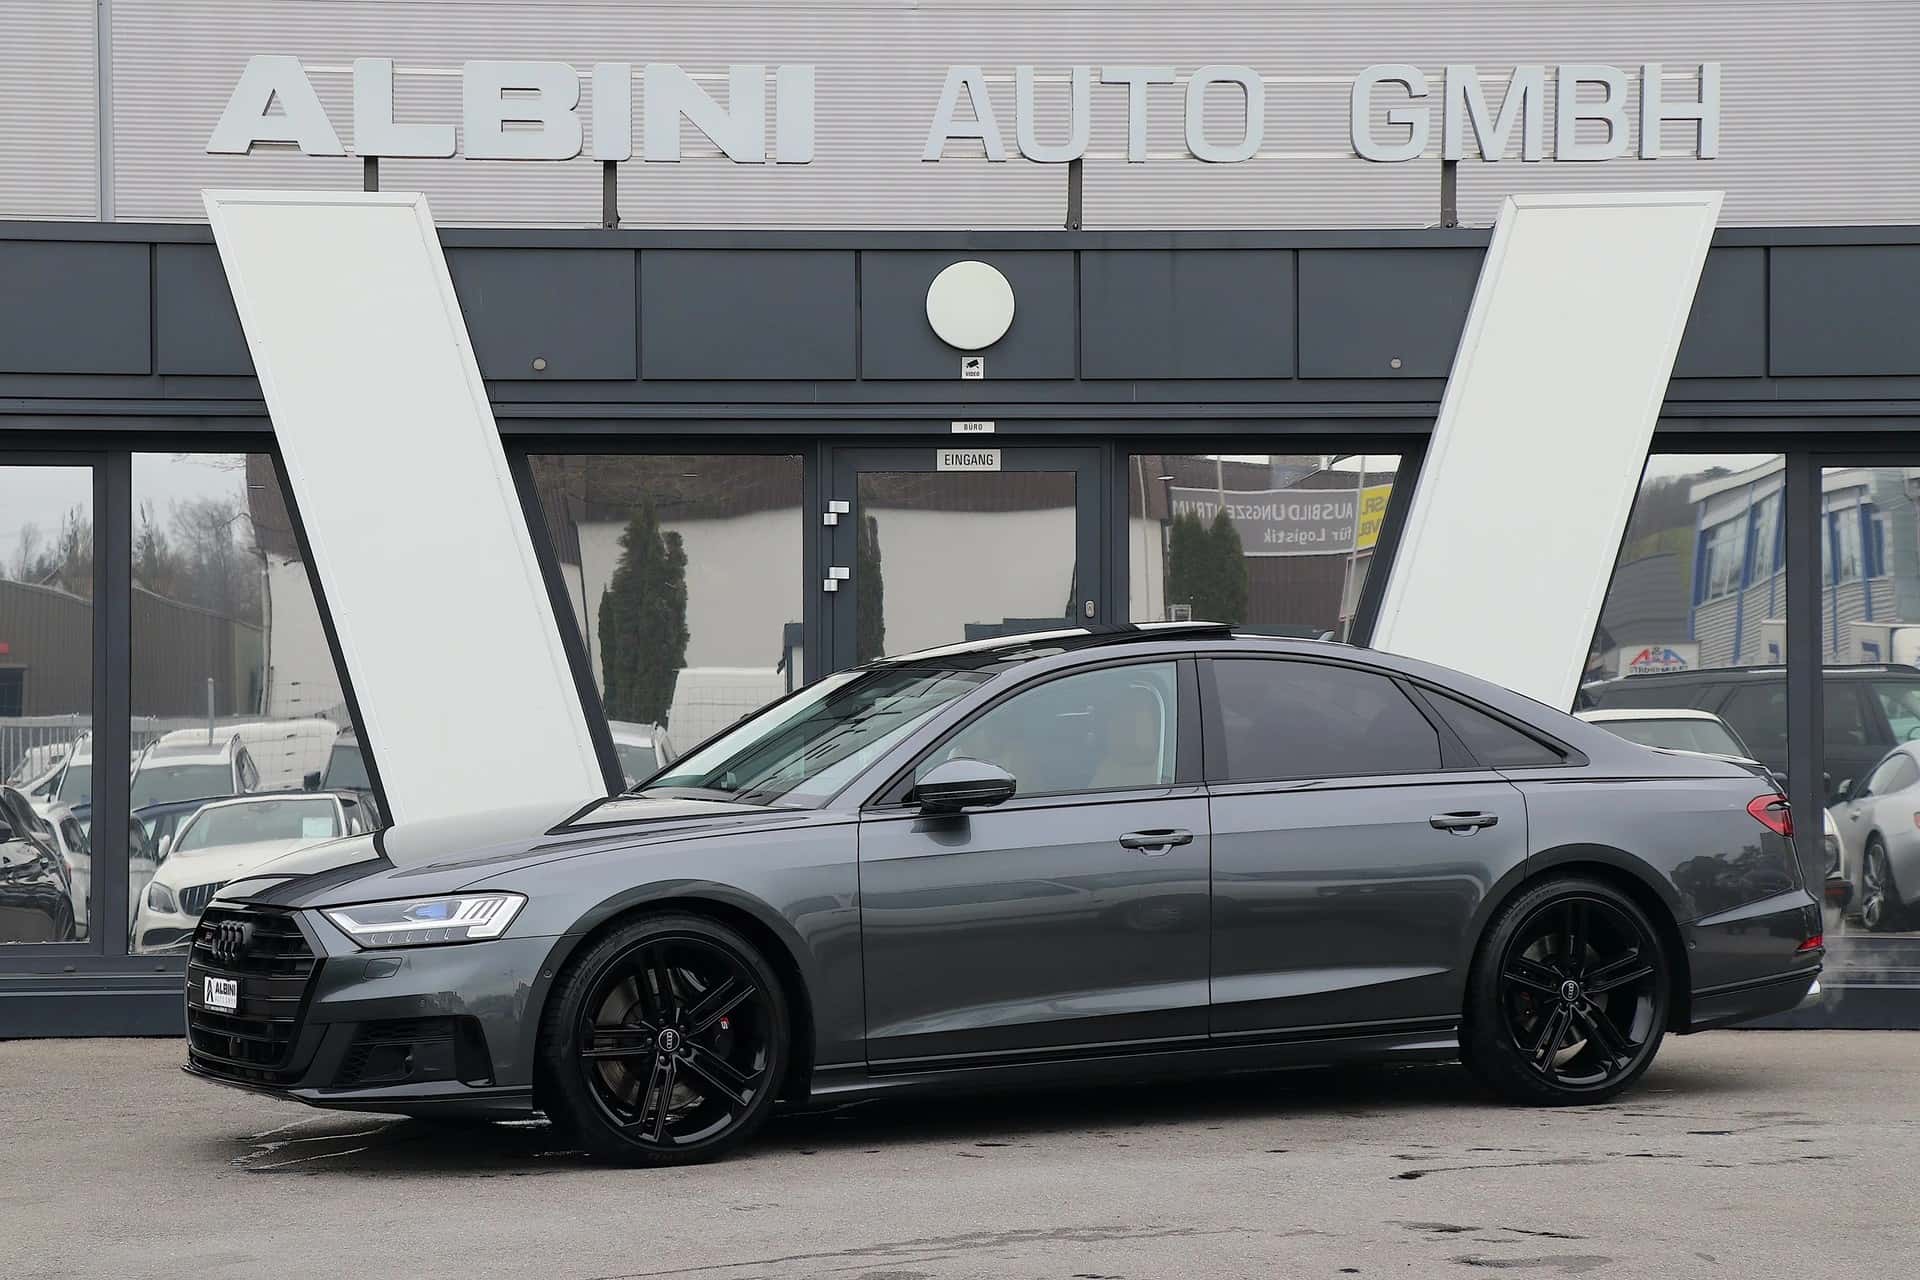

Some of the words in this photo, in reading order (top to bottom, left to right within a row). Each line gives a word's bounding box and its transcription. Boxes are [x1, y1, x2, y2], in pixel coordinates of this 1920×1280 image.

[205, 55, 816, 164] ALBINI
[921, 64, 1266, 163] AUTO
[1350, 62, 1721, 163] GMBH
[963, 423, 984, 431] BÜRO
[944, 453, 994, 466] EINGANG
[214, 981, 236, 997] ALBINI
